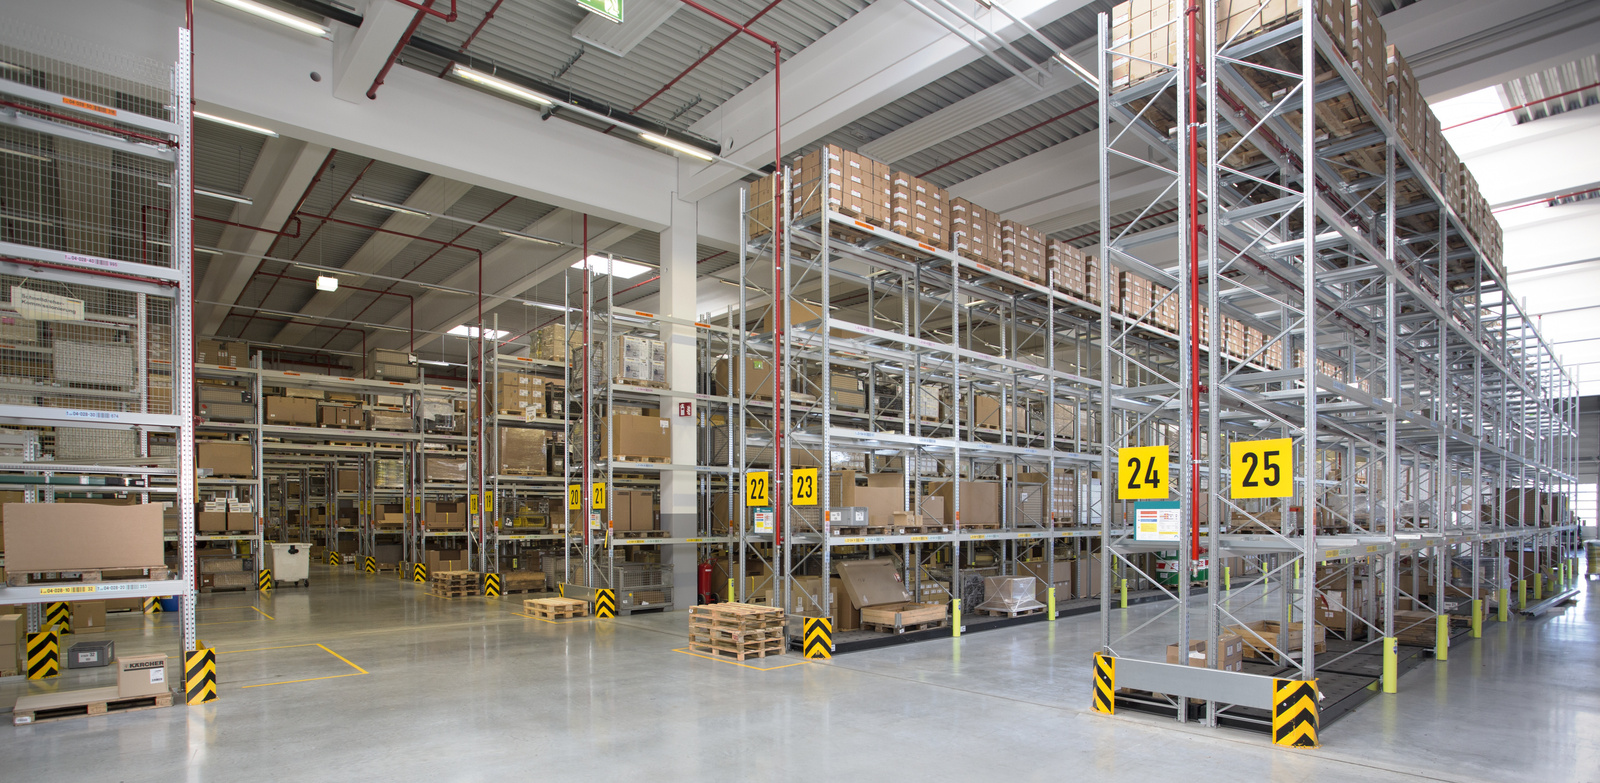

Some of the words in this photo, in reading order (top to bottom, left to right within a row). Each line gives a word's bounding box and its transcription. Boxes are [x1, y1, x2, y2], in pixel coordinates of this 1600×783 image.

[21, 299, 77, 315] Kommissionierung
[1127, 456, 1160, 489] 24
[1241, 450, 1280, 488] 25
[750, 478, 764, 499] 22
[797, 475, 813, 499] 23
[486, 494, 492, 508] 19
[571, 489, 579, 505] 20
[595, 487, 603, 504] 21
[471, 498, 477, 510] 18
[129, 660, 164, 668] KÄRCHER
